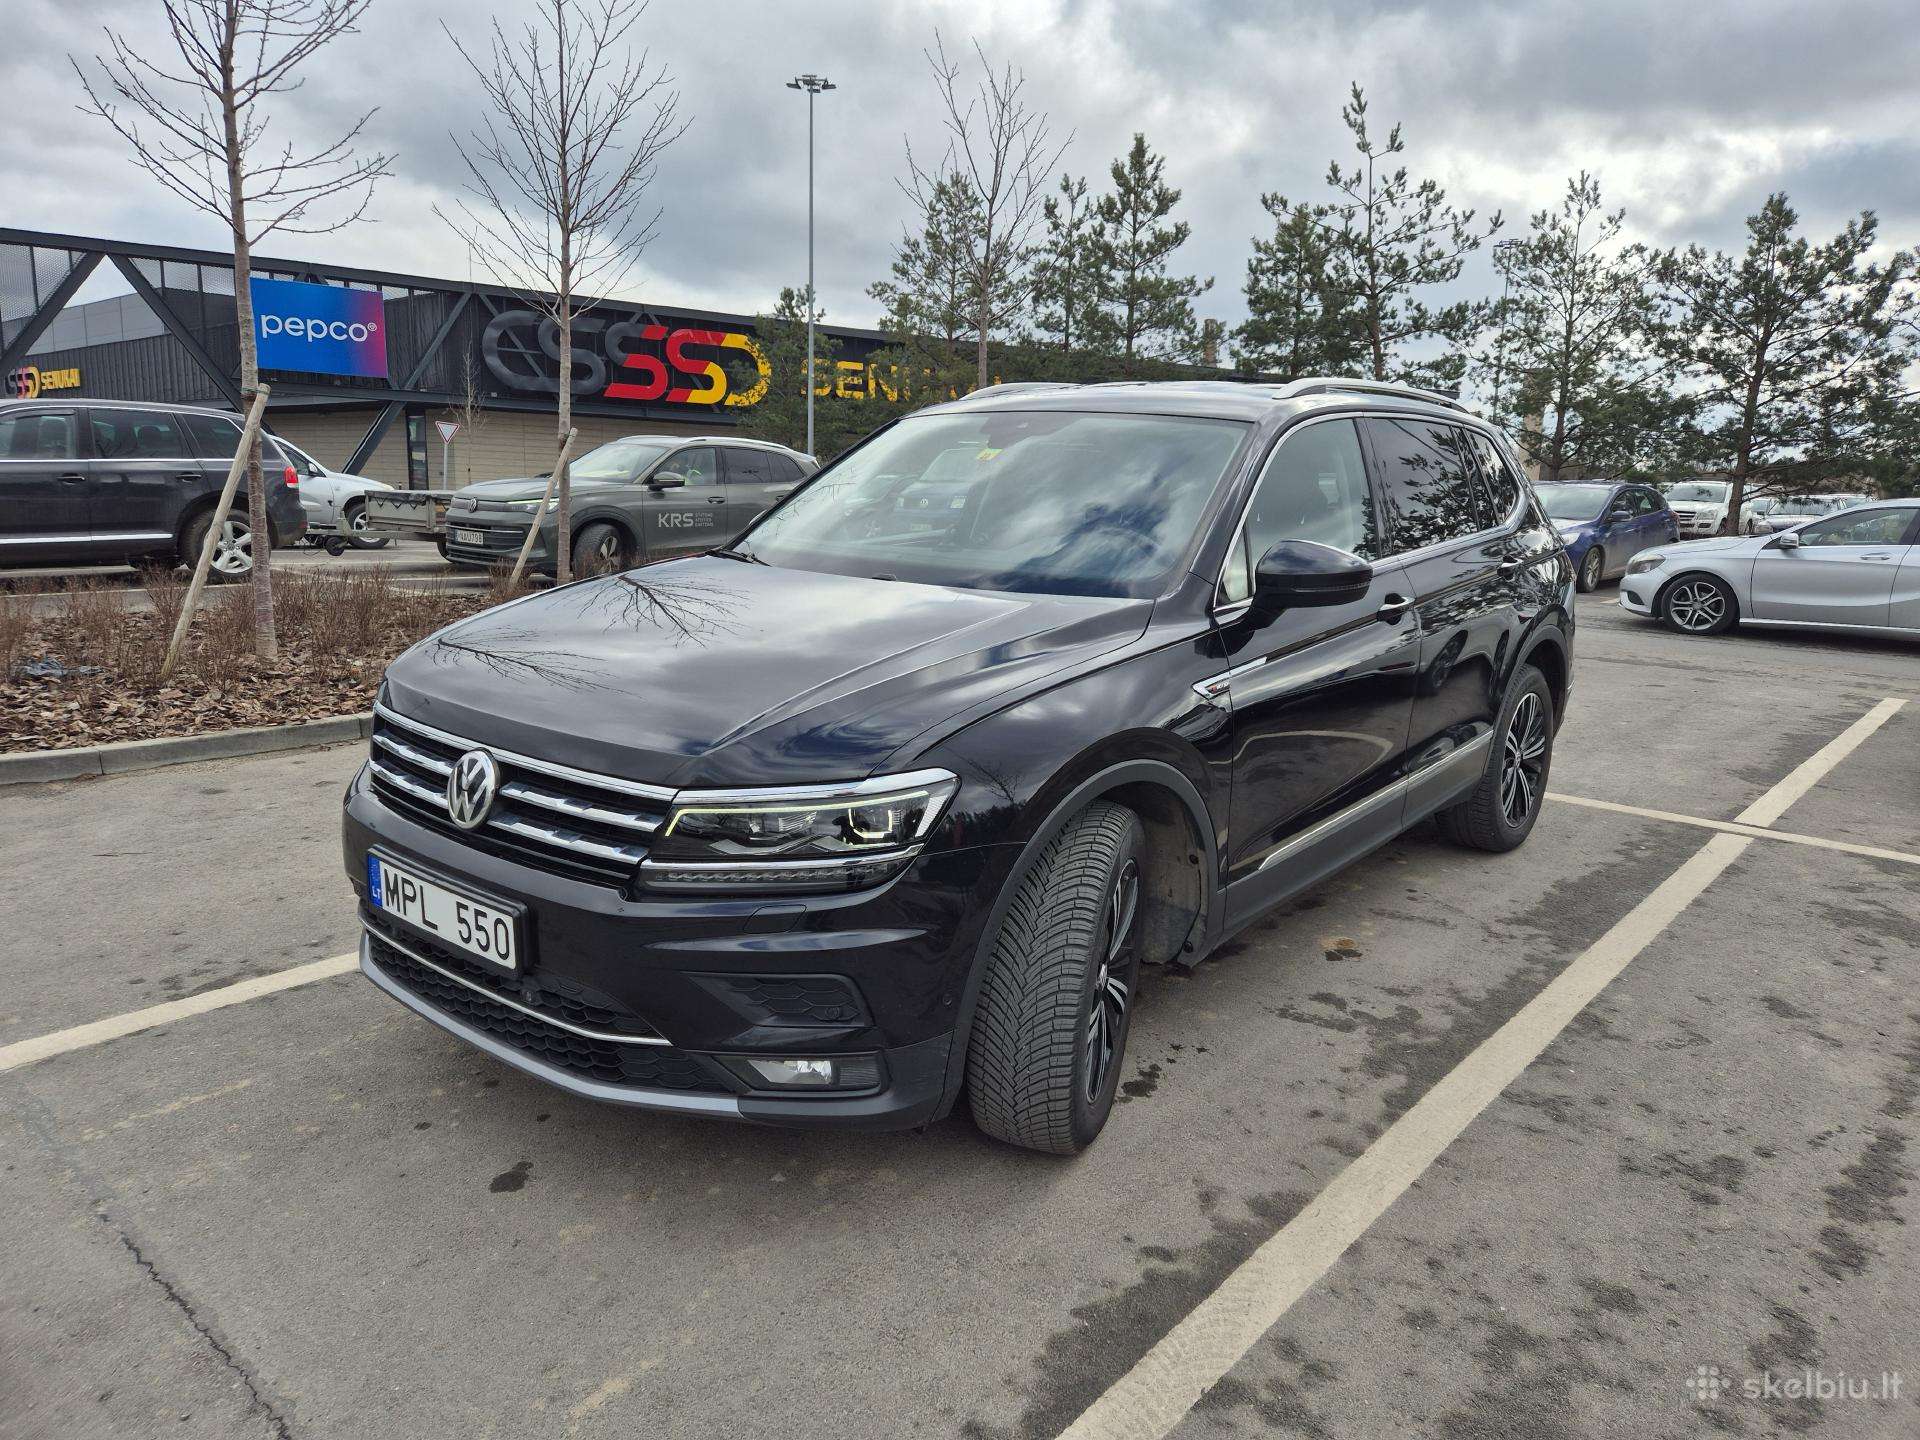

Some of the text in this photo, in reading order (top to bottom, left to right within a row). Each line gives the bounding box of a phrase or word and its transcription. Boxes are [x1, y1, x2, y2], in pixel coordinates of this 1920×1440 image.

[658, 512, 694, 528] KRS
[384, 868, 510, 961] MPL 550
